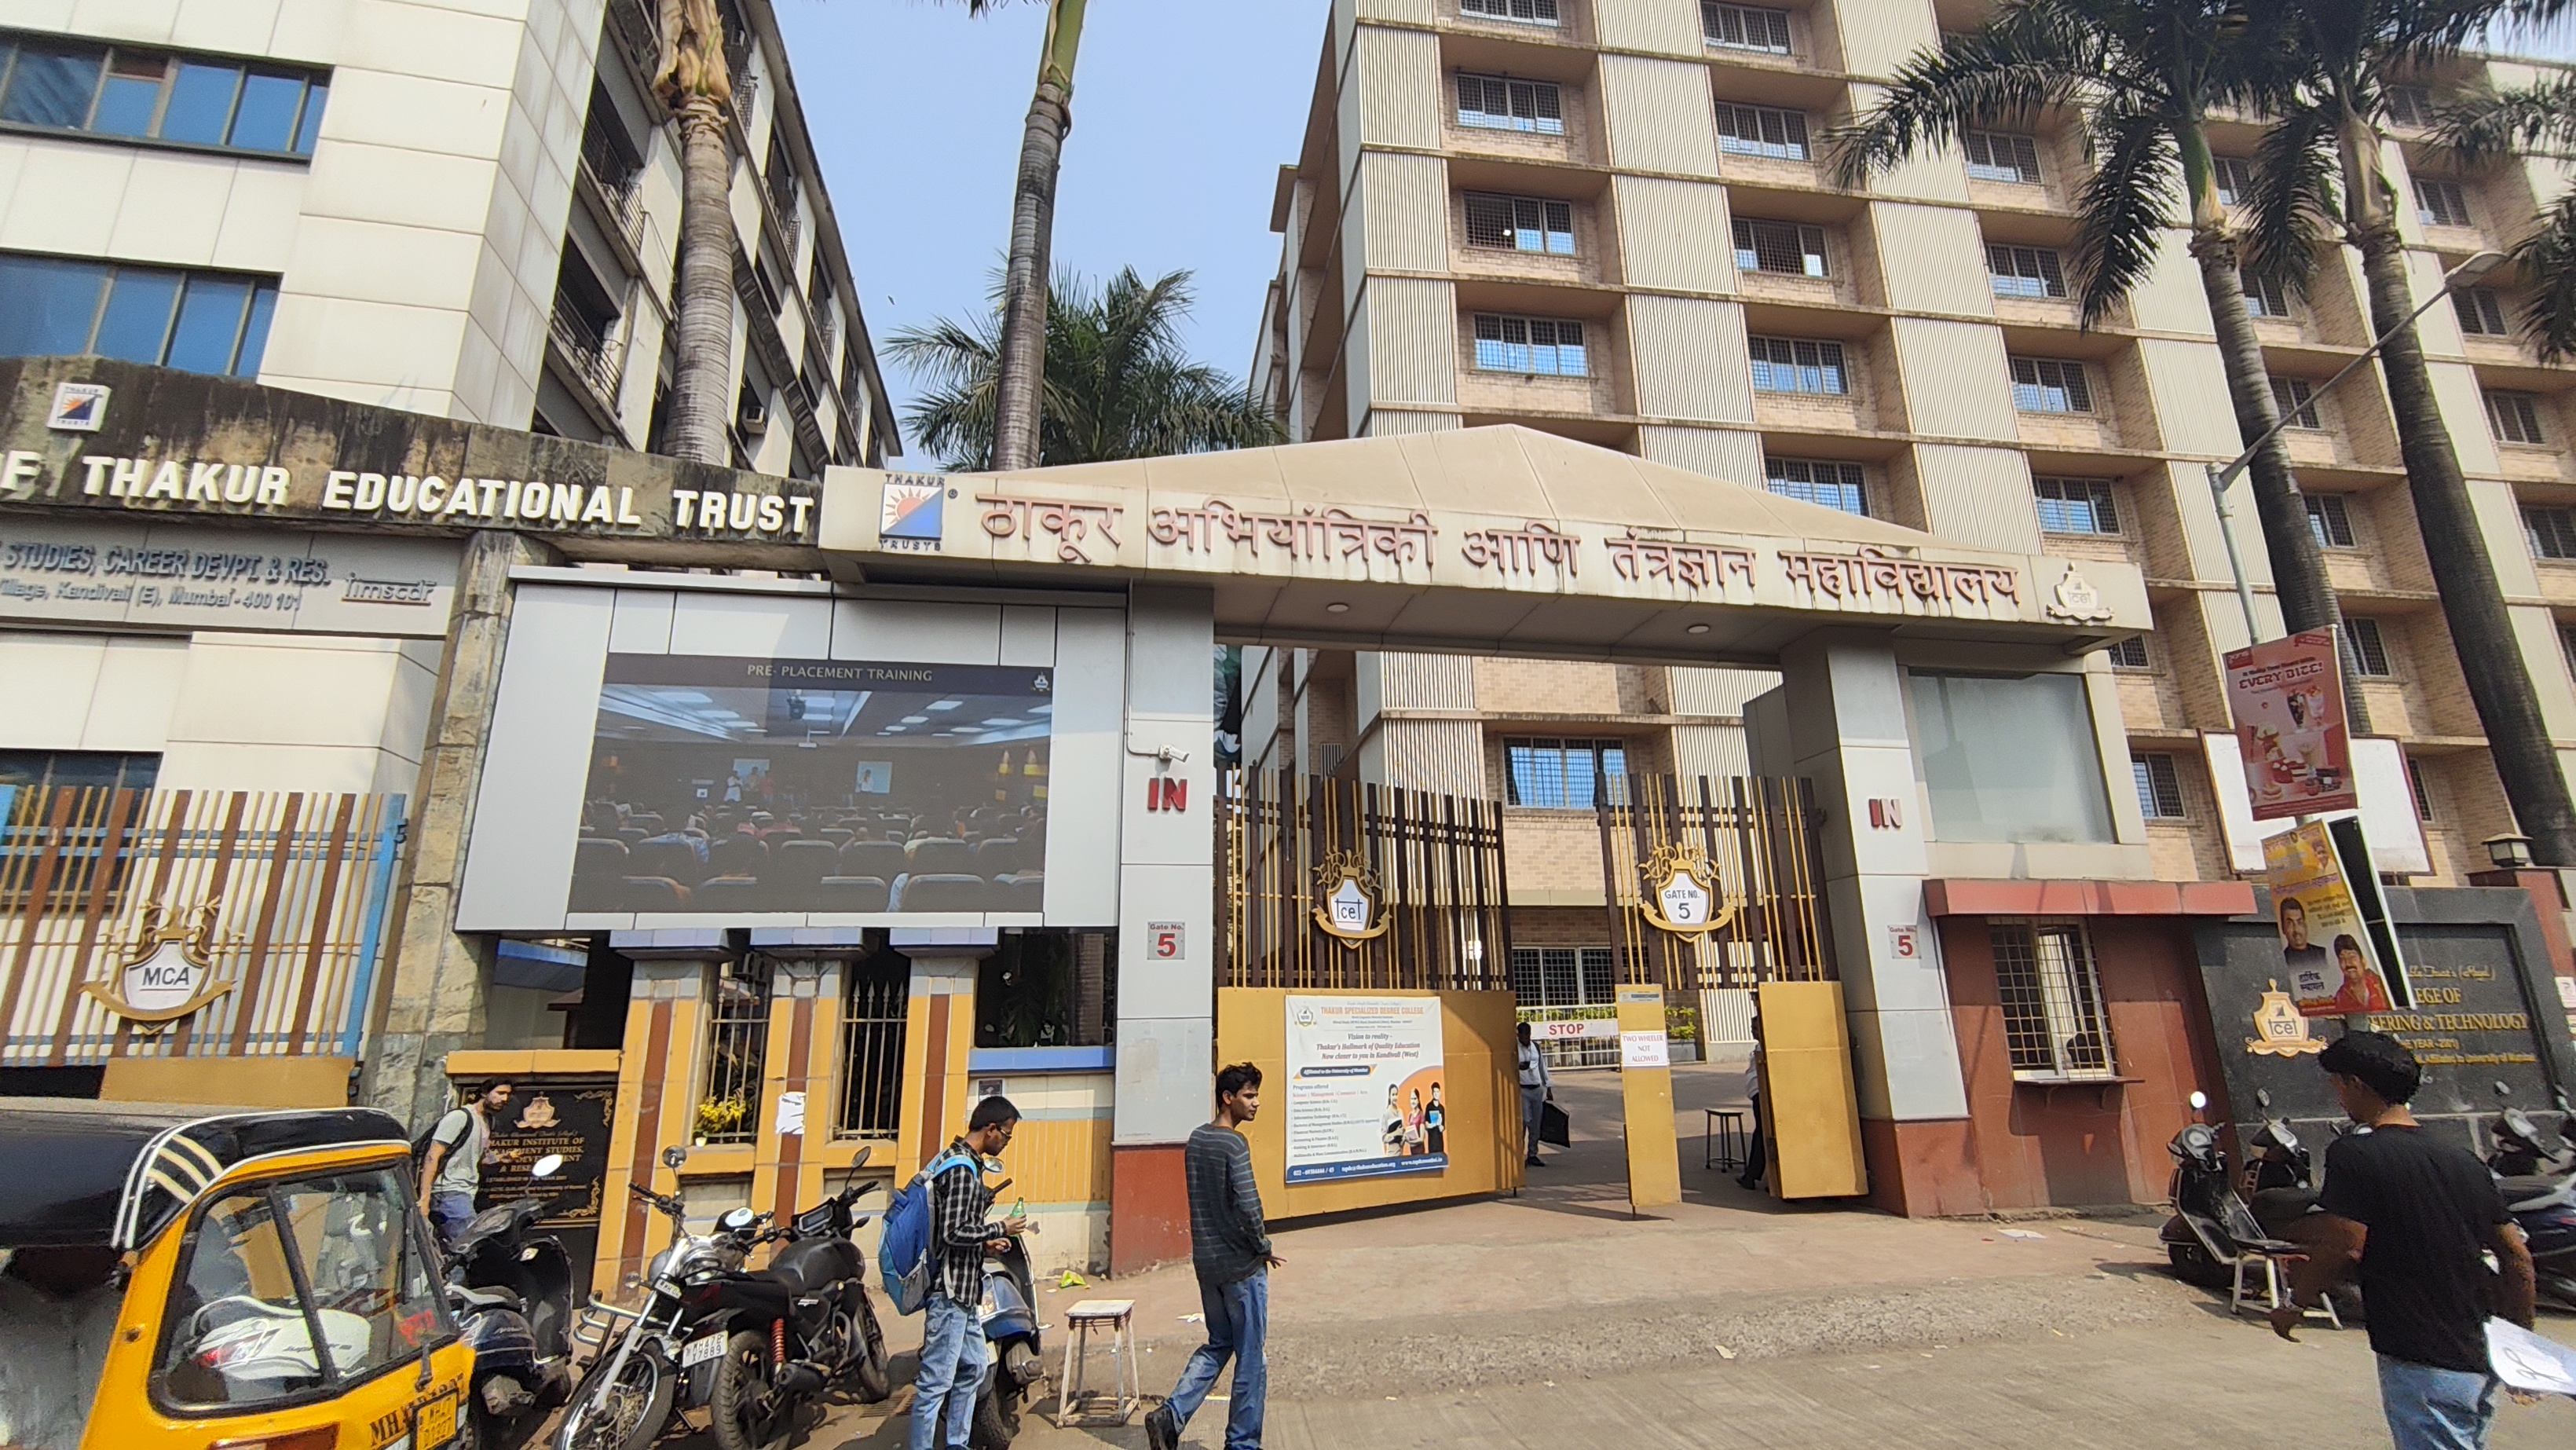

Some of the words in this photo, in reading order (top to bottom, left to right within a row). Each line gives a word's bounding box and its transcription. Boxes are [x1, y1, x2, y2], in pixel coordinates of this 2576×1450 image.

[885, 474, 945, 486] THAKUR
[0, 449, 42, 491] F
[82, 455, 292, 509] THAKUR
[322, 470, 642, 526] EDUCATIONAL
[672, 489, 814, 534] TRUST
[879, 539, 941, 551] TRUSTS
[975, 492, 1124, 564] ठाकूर
[1148, 496, 1439, 566] अभियांत्रिकी
[1462, 519, 1581, 578] आणि
[1604, 526, 1757, 589] तंत्रज्ञान
[1776, 544, 2021, 605] महाविद्यालय
[103, 549, 190, 578] CAREER
[265, 556, 280, 585] &
[284, 558, 331, 586] RES.
[55, 581, 132, 602] Kandivali
[168, 588, 236, 606] Mumbai
[243, 591, 272, 610] 400
[276, 592, 302, 612] 101
[781, 665, 863, 679] PLACEMENT
[867, 668, 933, 681] TRAINING
[2239, 672, 2281, 690] EVERY
[1147, 776, 1187, 811] IN
[1868, 798, 1902, 829] IN
[1664, 889, 1686, 899] GATE
[1688, 889, 1700, 899] NO.
[1678, 902, 1691, 920] 5
[1157, 932, 1176, 958] 5
[1897, 935, 1913, 956] 5
[142, 967, 190, 986] MCA
[2443, 987, 2462, 1005] OF
[1321, 1006, 1344, 1015] THAKUR
[1345, 1006, 1379, 1015] SPECIALIZED
[1380, 1006, 1400, 1015] DEGREE
[1401, 1006, 1425, 1015] COLLEGE
[1549, 1023, 1584, 1035] STOP
[2422, 1015, 2435, 1031] &
[2434, 1012, 2530, 1031] TECHNOLOGY
[1374, 1042, 1393, 1051] Quality
[522, 1137, 569, 1146] INSTITUTE
